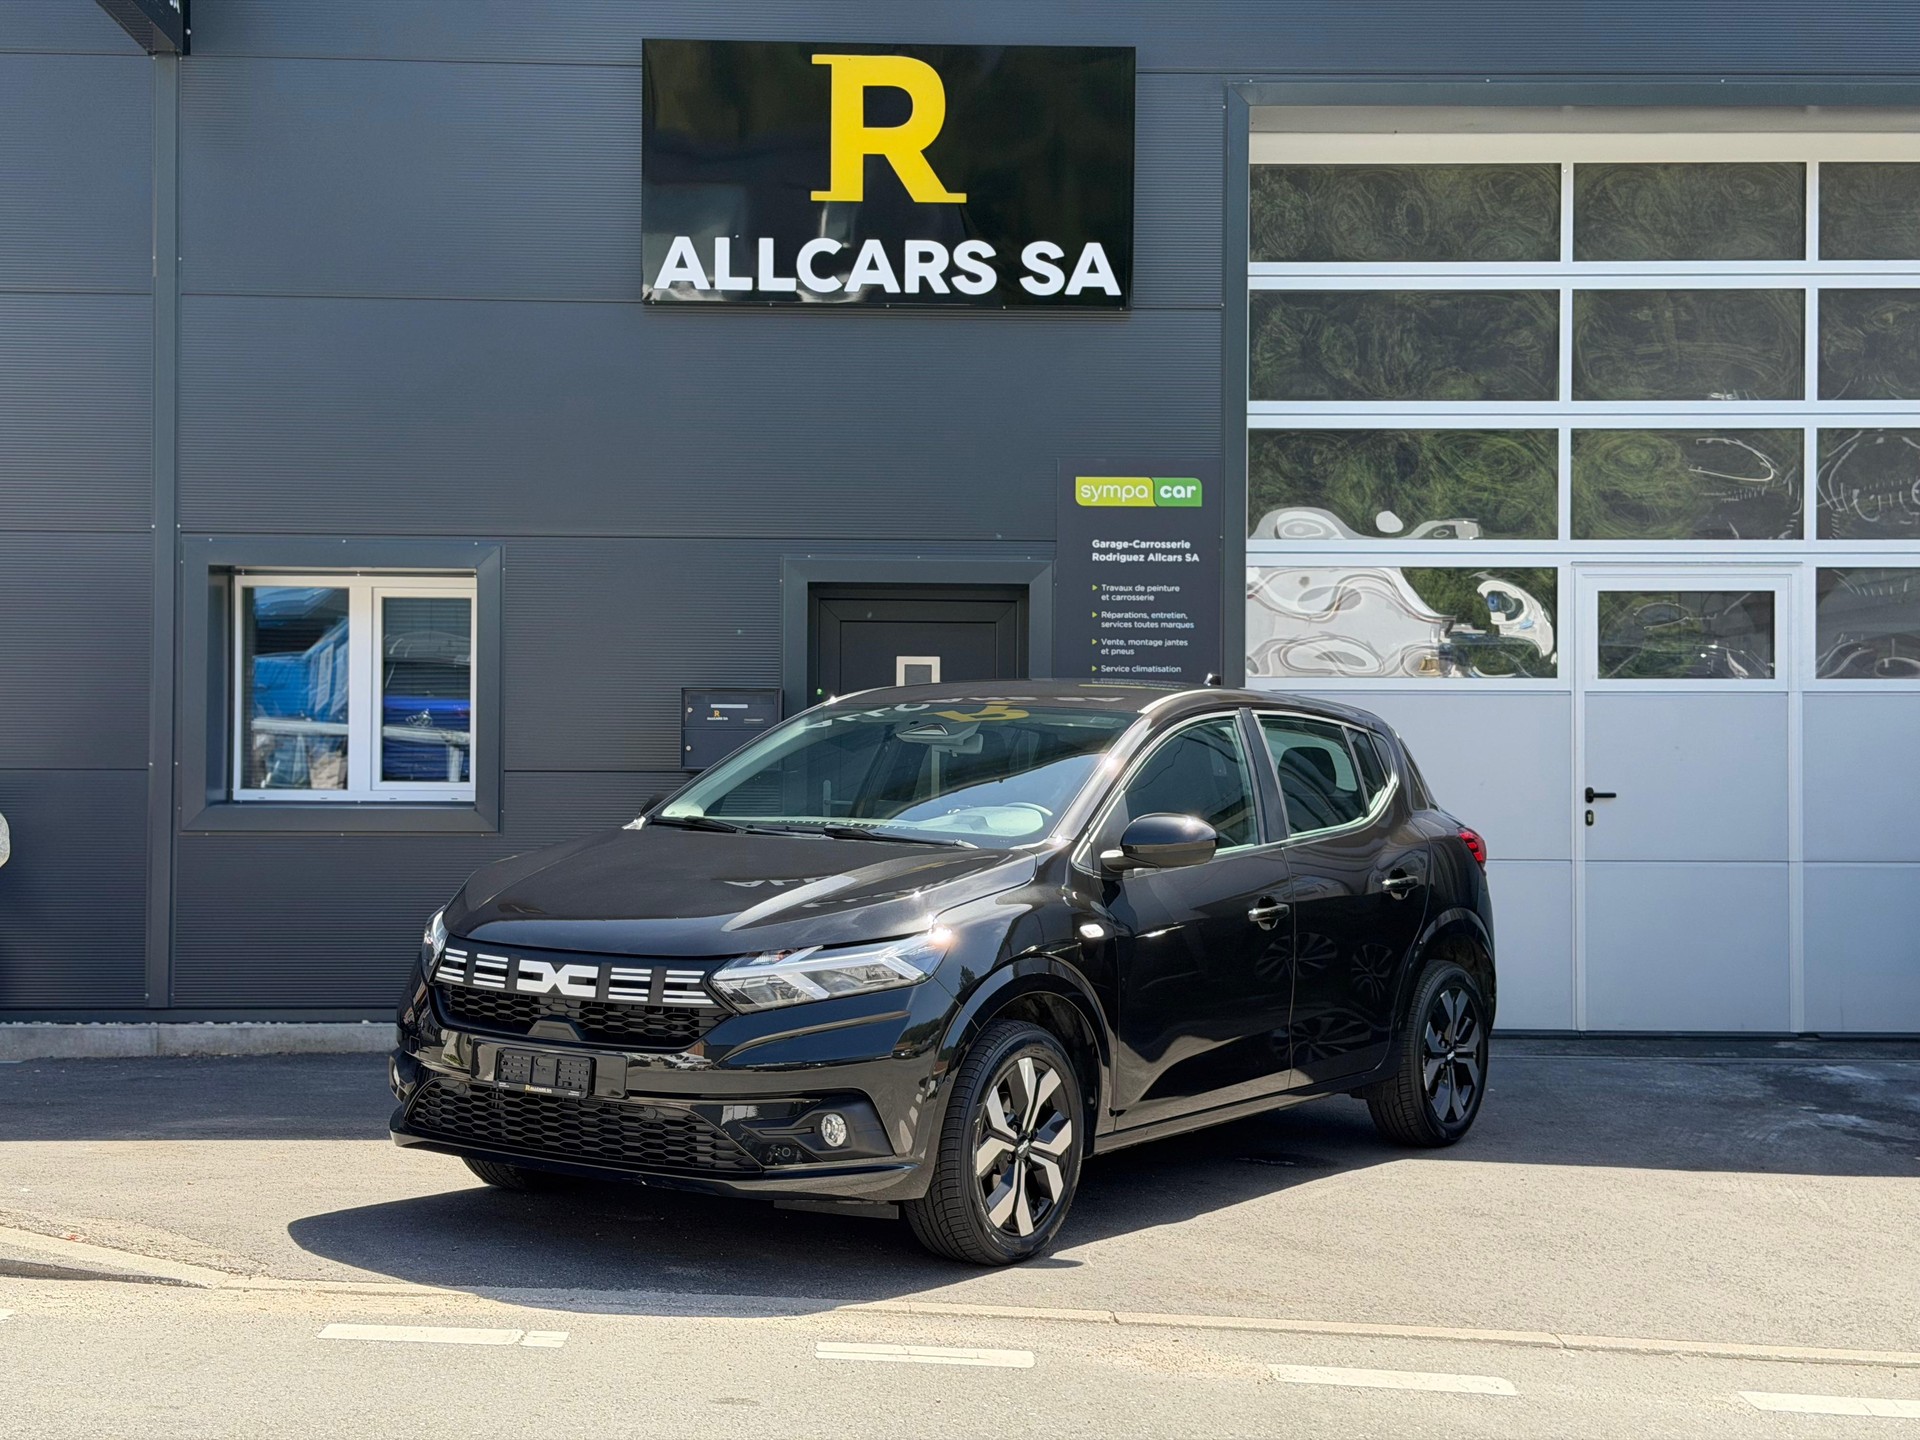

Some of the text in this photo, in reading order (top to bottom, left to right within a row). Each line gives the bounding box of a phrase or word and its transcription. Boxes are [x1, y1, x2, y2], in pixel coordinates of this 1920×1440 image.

[810, 53, 967, 204] R
[653, 235, 1122, 297] ALLCARS SA
[1080, 484, 1197, 503] sympa car
[1092, 539, 1191, 550] Garage-Carrosserie
[1092, 552, 1200, 563] Rodriguez Allcars SA
[1101, 584, 1180, 593] Travaux de peinture
[1101, 610, 1188, 620] Réparations, entretien,
[1101, 638, 1188, 647] Vente, montage jantes
[1111, 648, 1135, 656] pneus
[1101, 664, 1182, 673] Service climatisation
